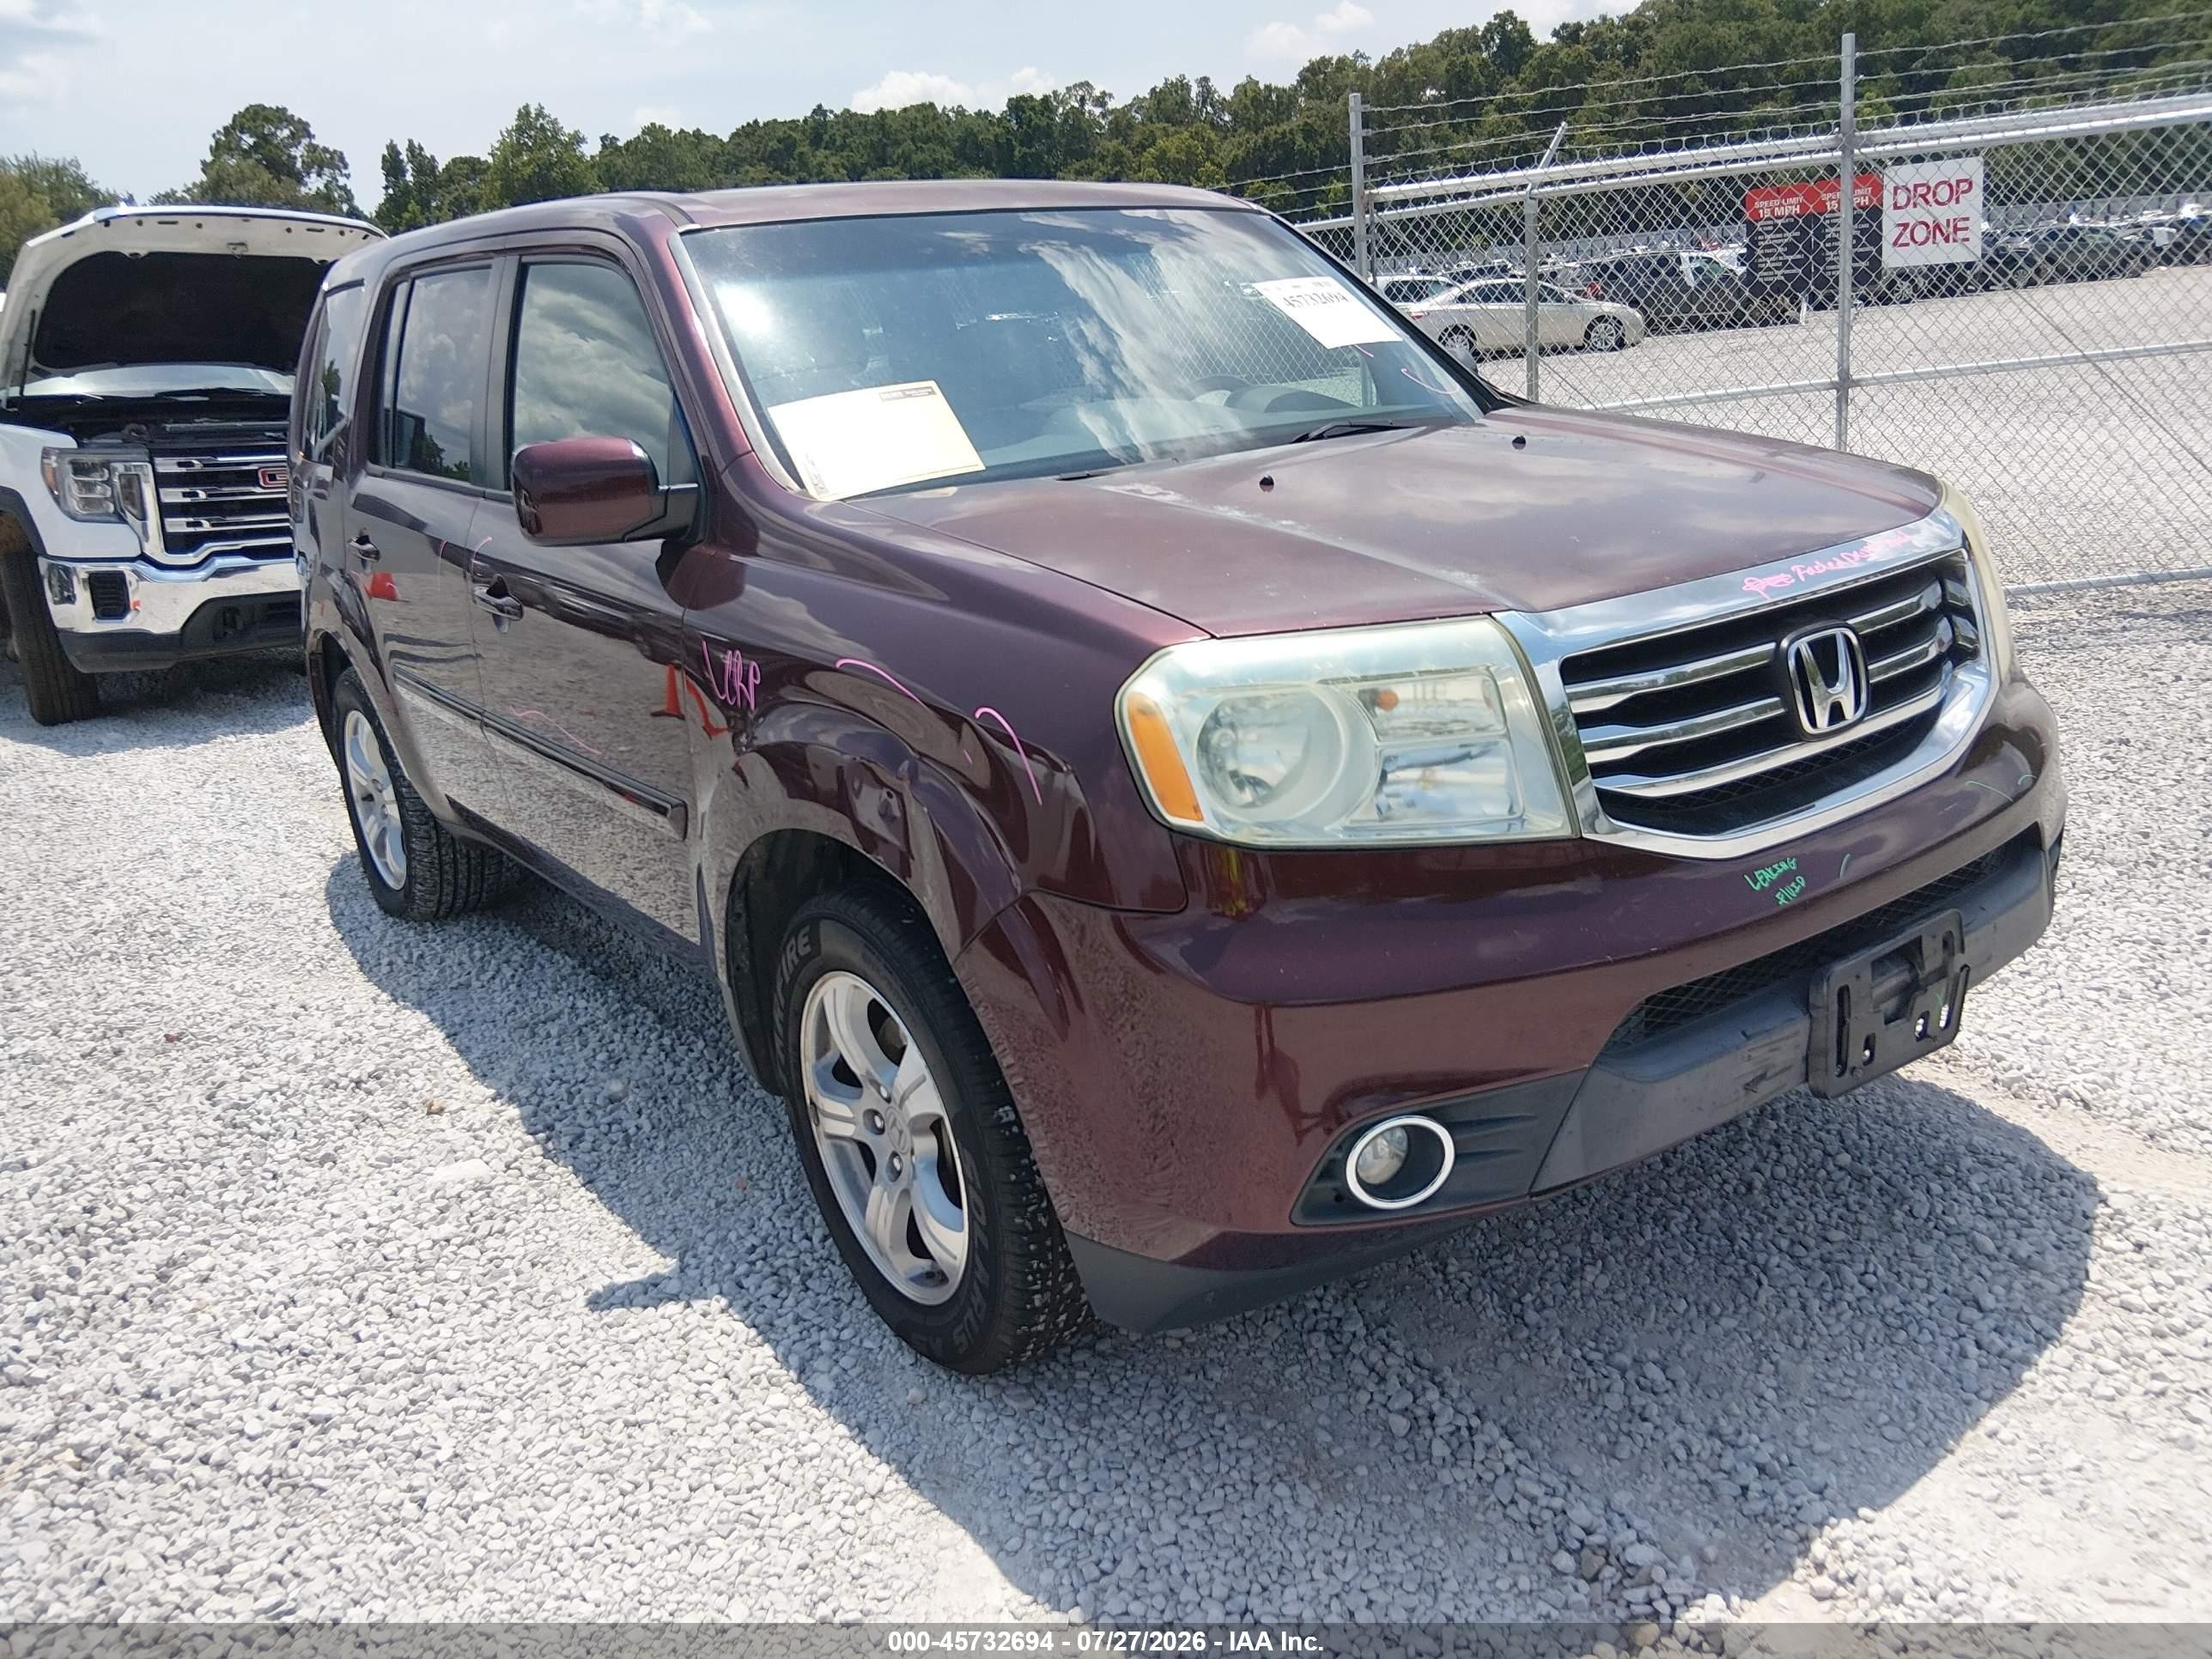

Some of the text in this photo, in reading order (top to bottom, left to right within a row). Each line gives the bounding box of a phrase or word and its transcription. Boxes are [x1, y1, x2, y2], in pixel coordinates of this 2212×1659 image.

[1892, 179, 1973, 211] DROP
[1754, 196, 1804, 210] SPEED LIMIT
[1826, 201, 1838, 210] 15
[1759, 205, 1801, 219] 15 MPH
[1892, 217, 1971, 248] ZONE
